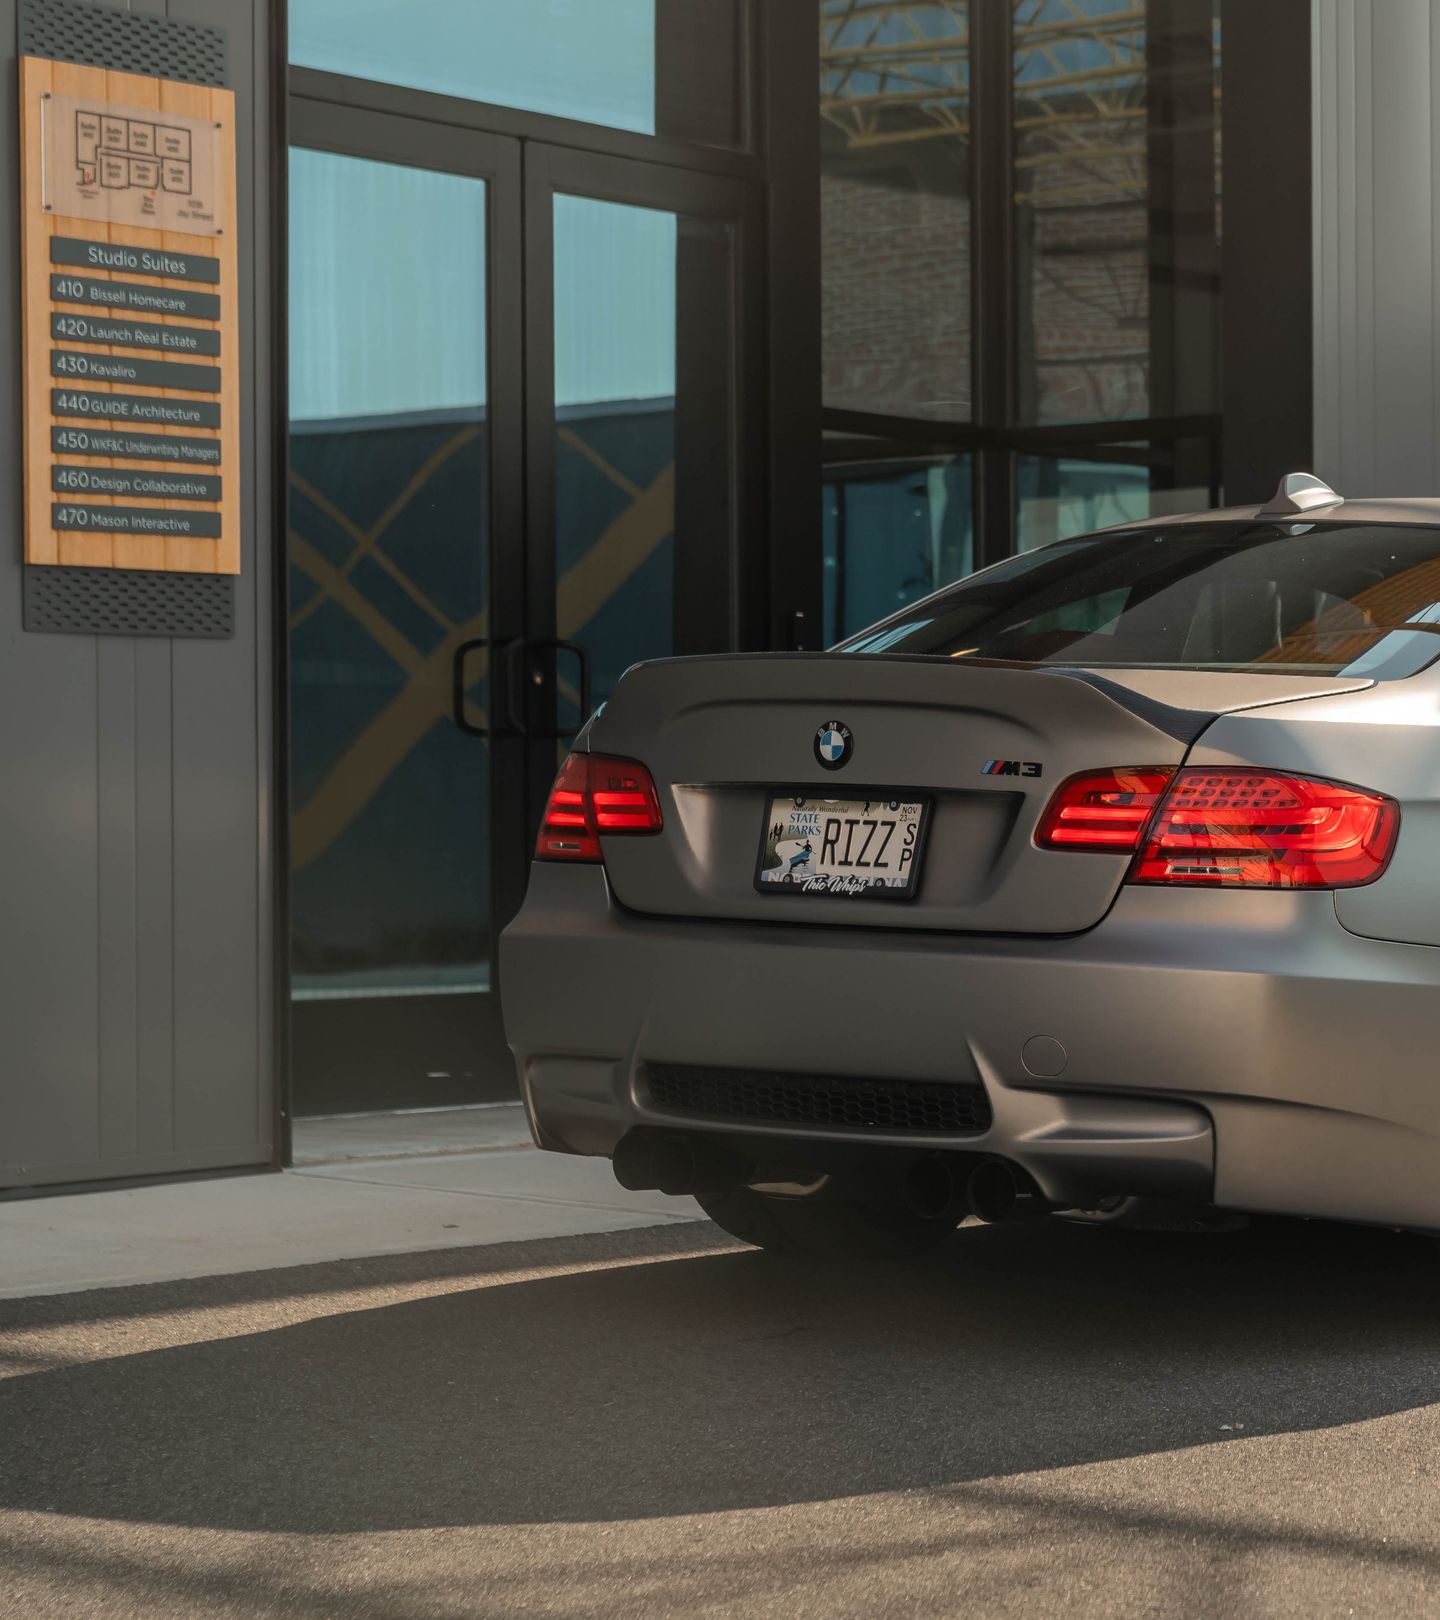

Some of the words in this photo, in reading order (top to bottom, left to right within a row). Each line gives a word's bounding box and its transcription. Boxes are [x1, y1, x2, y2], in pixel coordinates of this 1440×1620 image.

[88, 246, 137, 268] Studio
[142, 253, 186, 274] Suites
[57, 280, 83, 298] 410
[90, 287, 125, 304] Bissell
[129, 293, 186, 311] Homecare
[57, 318, 87, 337] 420
[90, 325, 132, 342] Launch
[134, 330, 159, 345] Real
[162, 334, 197, 349] Estate
[57, 356, 87, 374] 430
[90, 362, 136, 379] Kavaliro
[57, 393, 89, 412] 440
[91, 402, 128, 416] GUIDE
[132, 404, 200, 421] Architecture
[57, 432, 89, 449] 450
[126, 441, 179, 459] Underwriting
[181, 446, 219, 460] Managers
[57, 471, 89, 488] 460
[91, 475, 130, 491] Design
[133, 478, 207, 495] Collaborative
[57, 508, 87, 525] 470
[91, 513, 129, 527] Mason
[131, 516, 190, 531] Interactive
[817, 722, 851, 738] BMW
[1000, 760, 1042, 777] M3
[790, 813, 819, 823] STATE
[902, 806, 918, 814] NOV
[788, 825, 822, 836] PARKS
[820, 818, 896, 867] RIZZ
